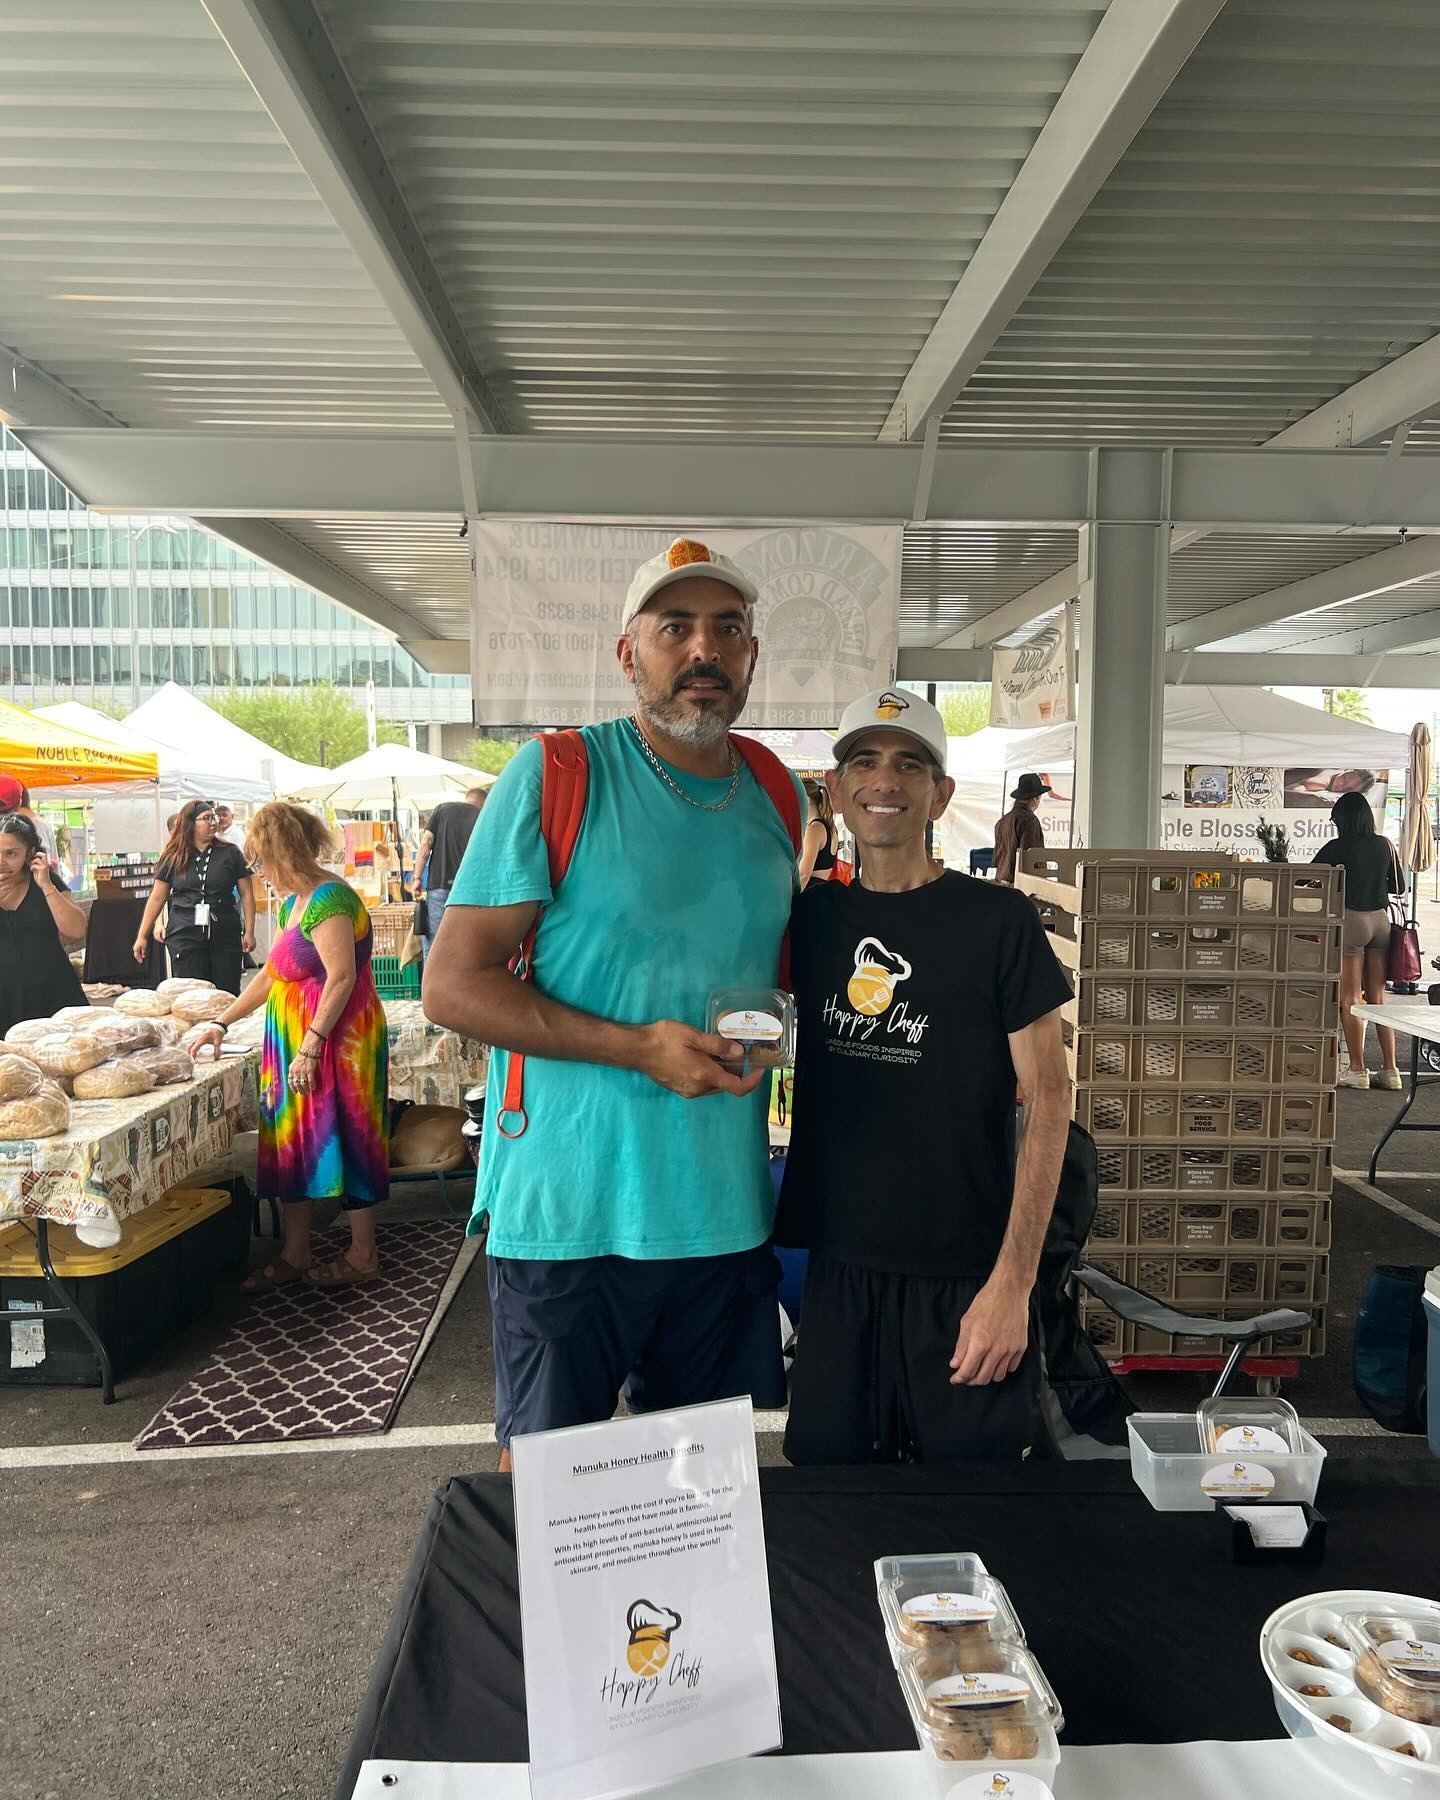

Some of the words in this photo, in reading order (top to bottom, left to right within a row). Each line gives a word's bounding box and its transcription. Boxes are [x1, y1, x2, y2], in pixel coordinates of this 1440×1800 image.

[36, 746, 82, 762] NOBLE
[1159, 818, 1193, 843] ple
[1231, 842, 1260, 857] from
[823, 994, 881, 1040] Happy
[887, 1001, 929, 1043] Cheff
[837, 1047, 870, 1059] CULINARY
[872, 1053, 918, 1065] CURIOSITY
[851, 1043, 880, 1053] FOODS
[881, 1046, 922, 1058] INSPIRED
[573, 1461, 608, 1475] Manuka
[611, 1457, 639, 1467] Honey
[640, 1449, 669, 1462] Health
[548, 1515, 577, 1527] Manuka
[579, 1511, 600, 1521] Honey
[602, 1509, 608, 1517] is
[609, 1505, 629, 1515] worth
[631, 1503, 642, 1511] the
[643, 1500, 657, 1509] cost
[658, 1497, 663, 1505] if
[664, 1495, 686, 1506] you're
[711, 1487, 721, 1495] for
[722, 1484, 733, 1493] the
[554, 1544, 571, 1554] With
[583, 1539, 598, 1548] high
[600, 1535, 619, 1545] levels
[620, 1532, 627, 1541] of
[628, 1523, 675, 1539] anti-bacterial,
[676, 1513, 719, 1529] antimicrobial
[720, 1511, 732, 1519] and
[574, 1523, 597, 1534] health
[598, 1518, 625, 1530] benefits
[627, 1515, 640, 1523] that
[641, 1512, 658, 1521] have
[659, 1508, 678, 1517] made
[553, 1552, 593, 1567] antioxidant
[594, 1546, 631, 1559] properties,
[633, 1539, 660, 1550] manuka
[661, 1535, 681, 1544] honey
[682, 1532, 688, 1540] is
[689, 1528, 705, 1538] used
[706, 1527, 713, 1535] in
[714, 1523, 734, 1533] foods,
[570, 1563, 601, 1576] skincare,
[602, 1559, 615, 1568] and
[616, 1553, 647, 1566] medicine
[648, 1544, 686, 1559] throughout
[687, 1542, 698, 1551] the
[699, 1536, 721, 1548] world!
[600, 1666, 662, 1709] Happy
[669, 1648, 703, 1688] Cheff
